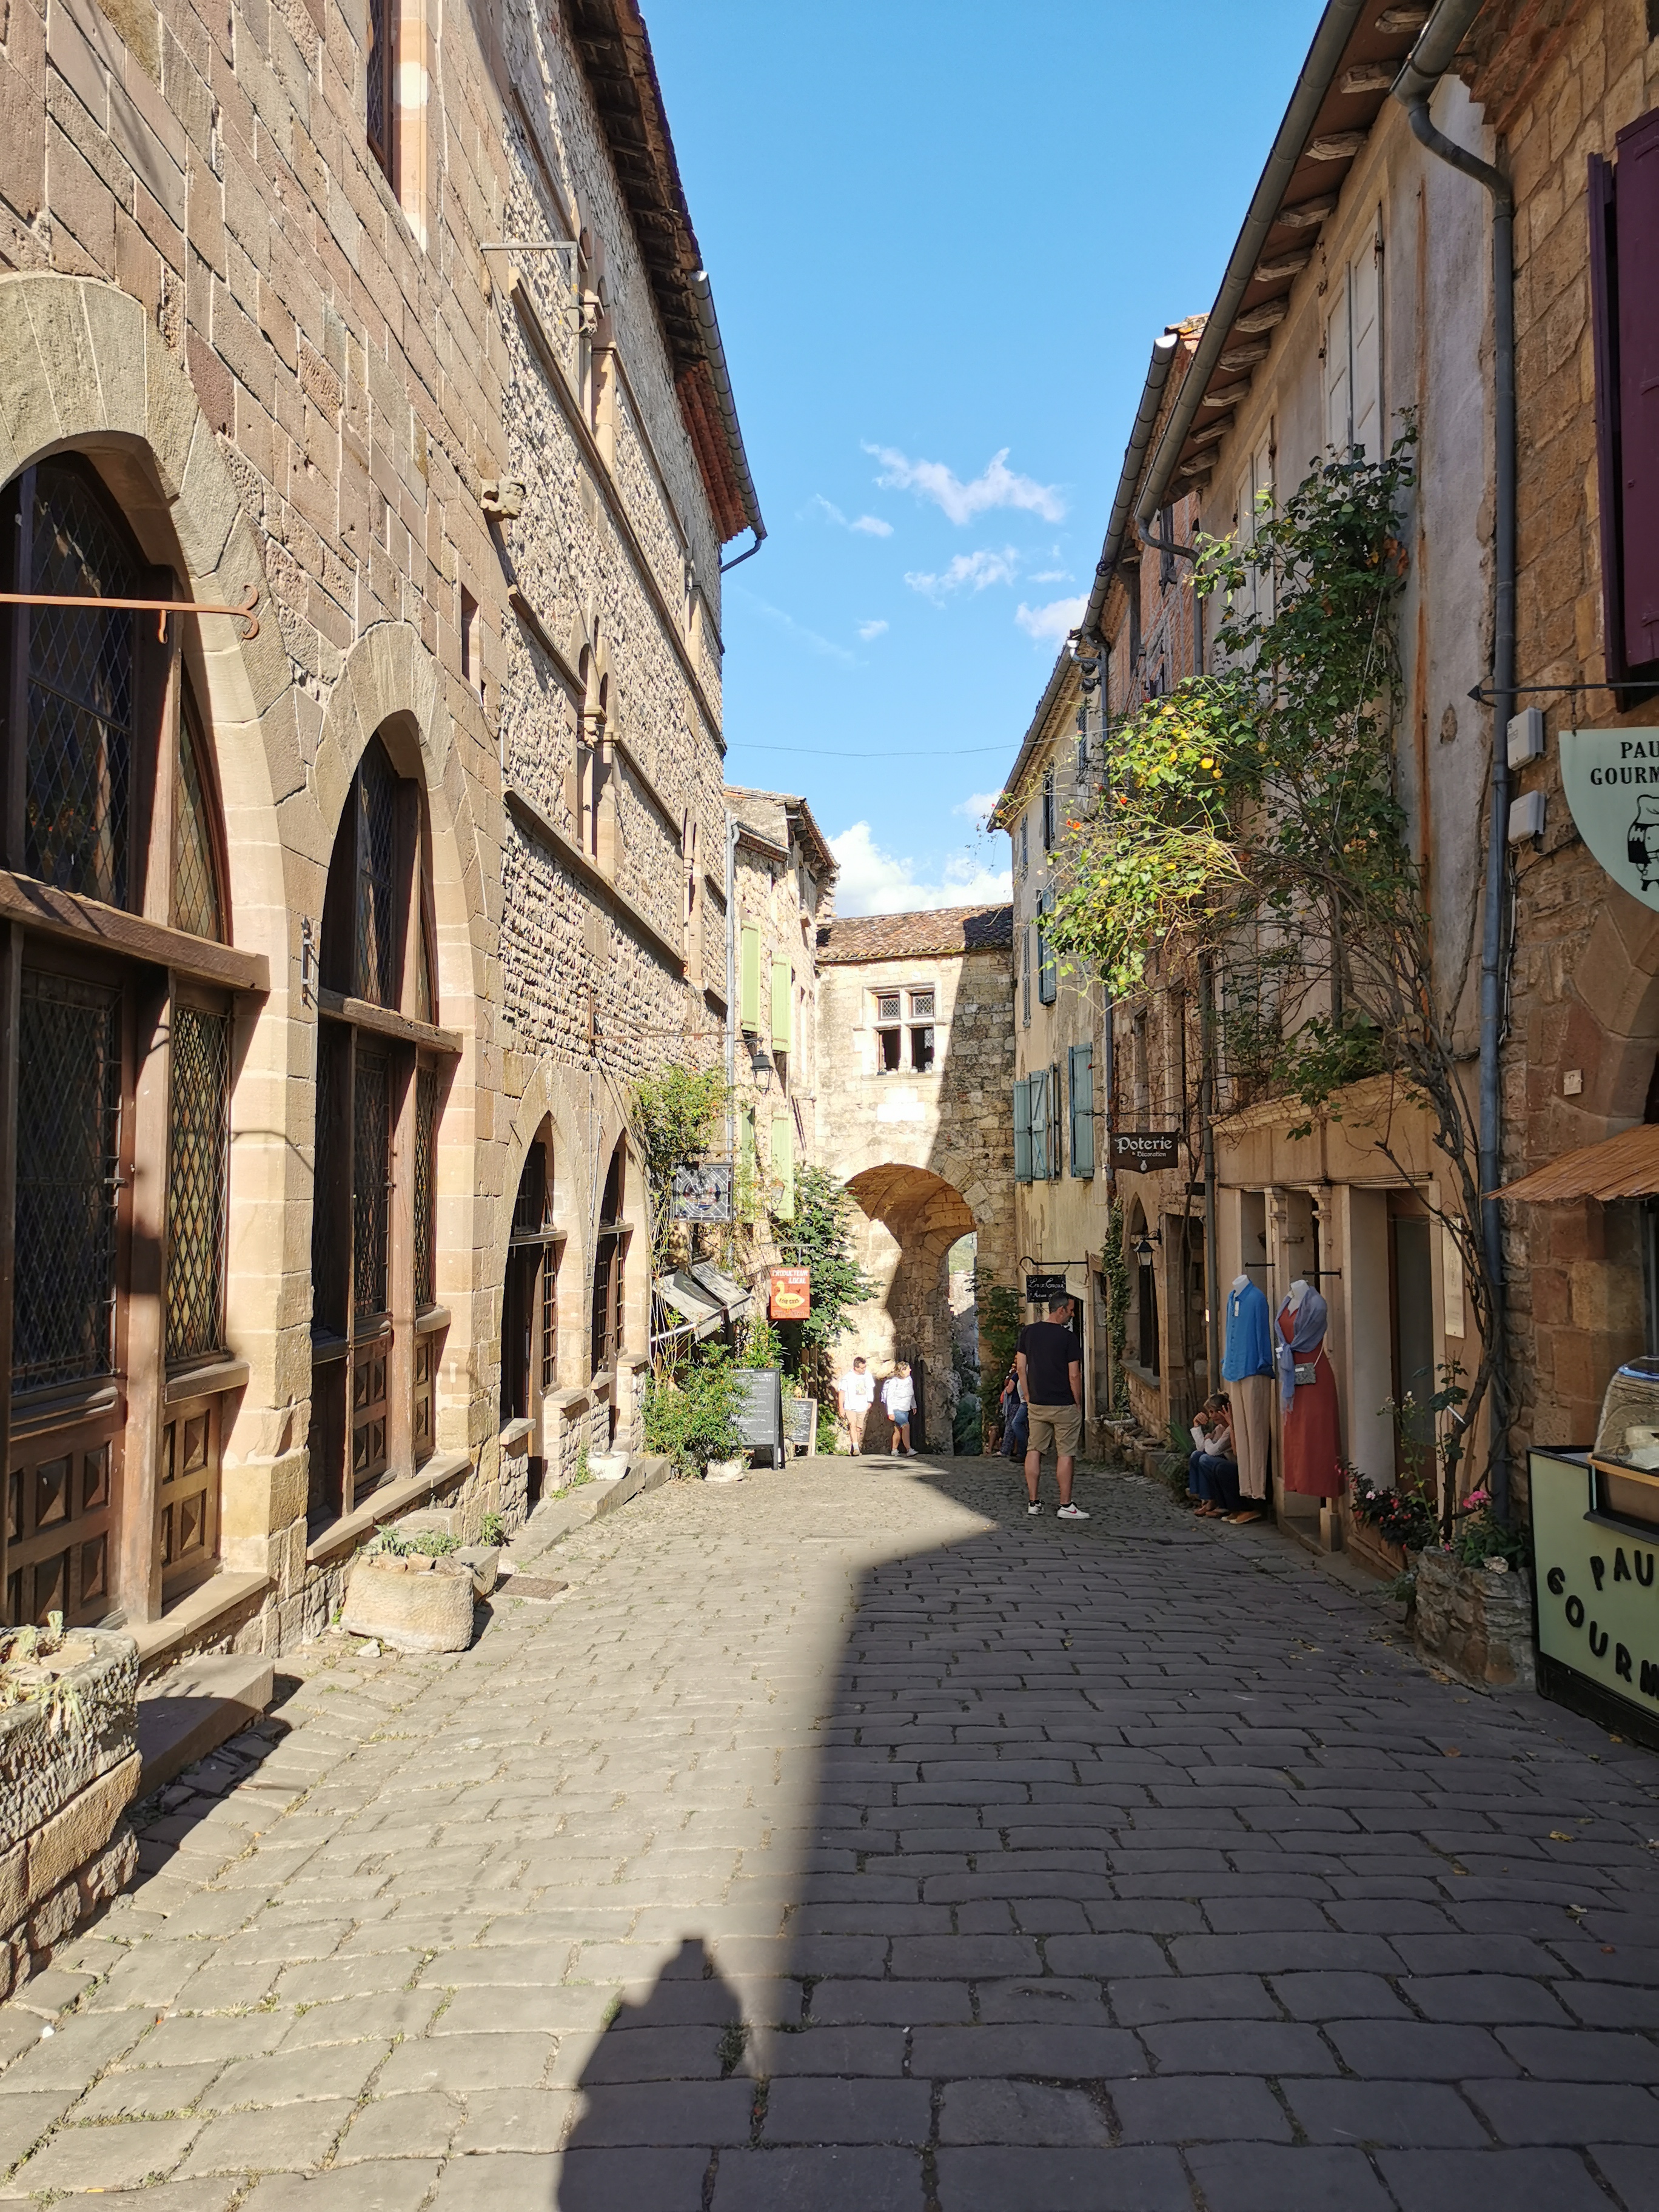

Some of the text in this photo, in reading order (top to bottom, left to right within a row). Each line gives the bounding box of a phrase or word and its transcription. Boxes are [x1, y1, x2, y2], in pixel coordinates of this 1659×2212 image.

[1620, 741, 1659, 759] PAU
[1114, 1136, 1172, 1153] Poterie
[1590, 1547, 1654, 1591] PAU
